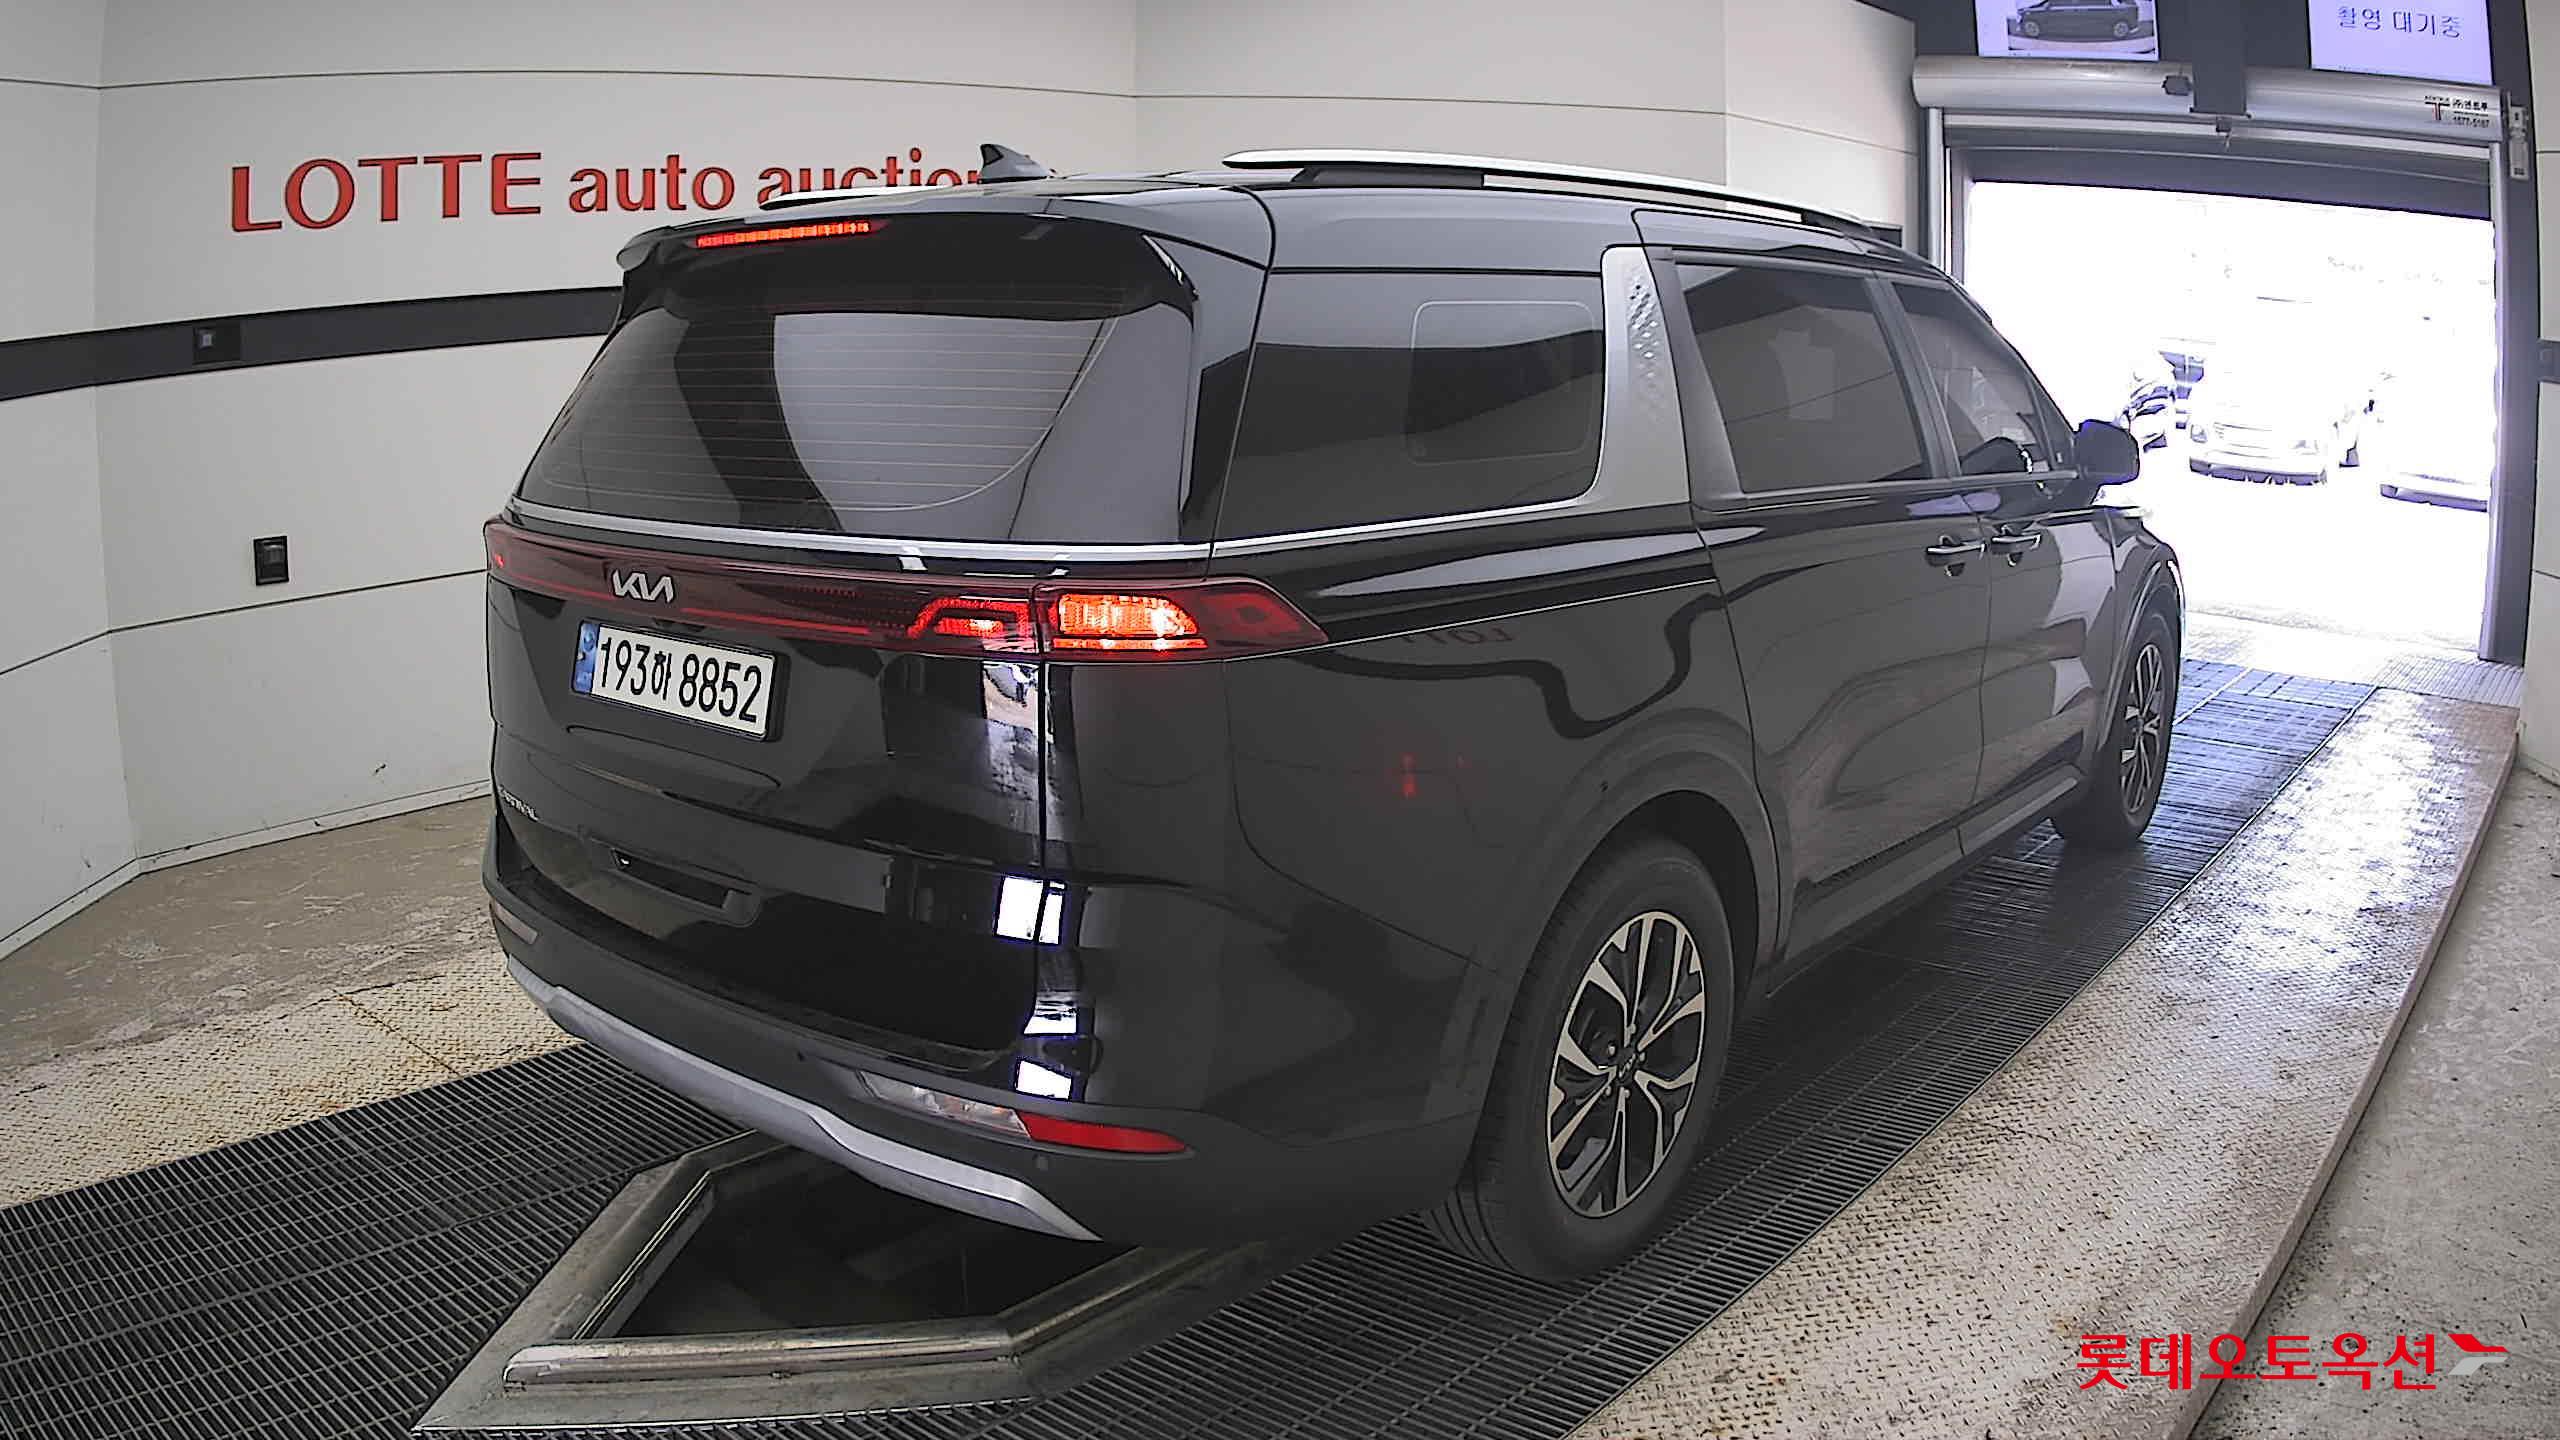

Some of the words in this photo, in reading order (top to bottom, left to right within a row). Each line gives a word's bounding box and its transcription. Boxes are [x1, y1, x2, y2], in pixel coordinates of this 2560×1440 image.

[2338, 6, 2382, 31] 촬영
[2392, 11, 2461, 39] 대기중
[231, 151, 542, 233] LOTTE
[568, 153, 736, 214] auto
[757, 147, 978, 204] aucti
[610, 568, 676, 603] KIA
[600, 636, 672, 701] 193하
[678, 652, 762, 724] 8852
